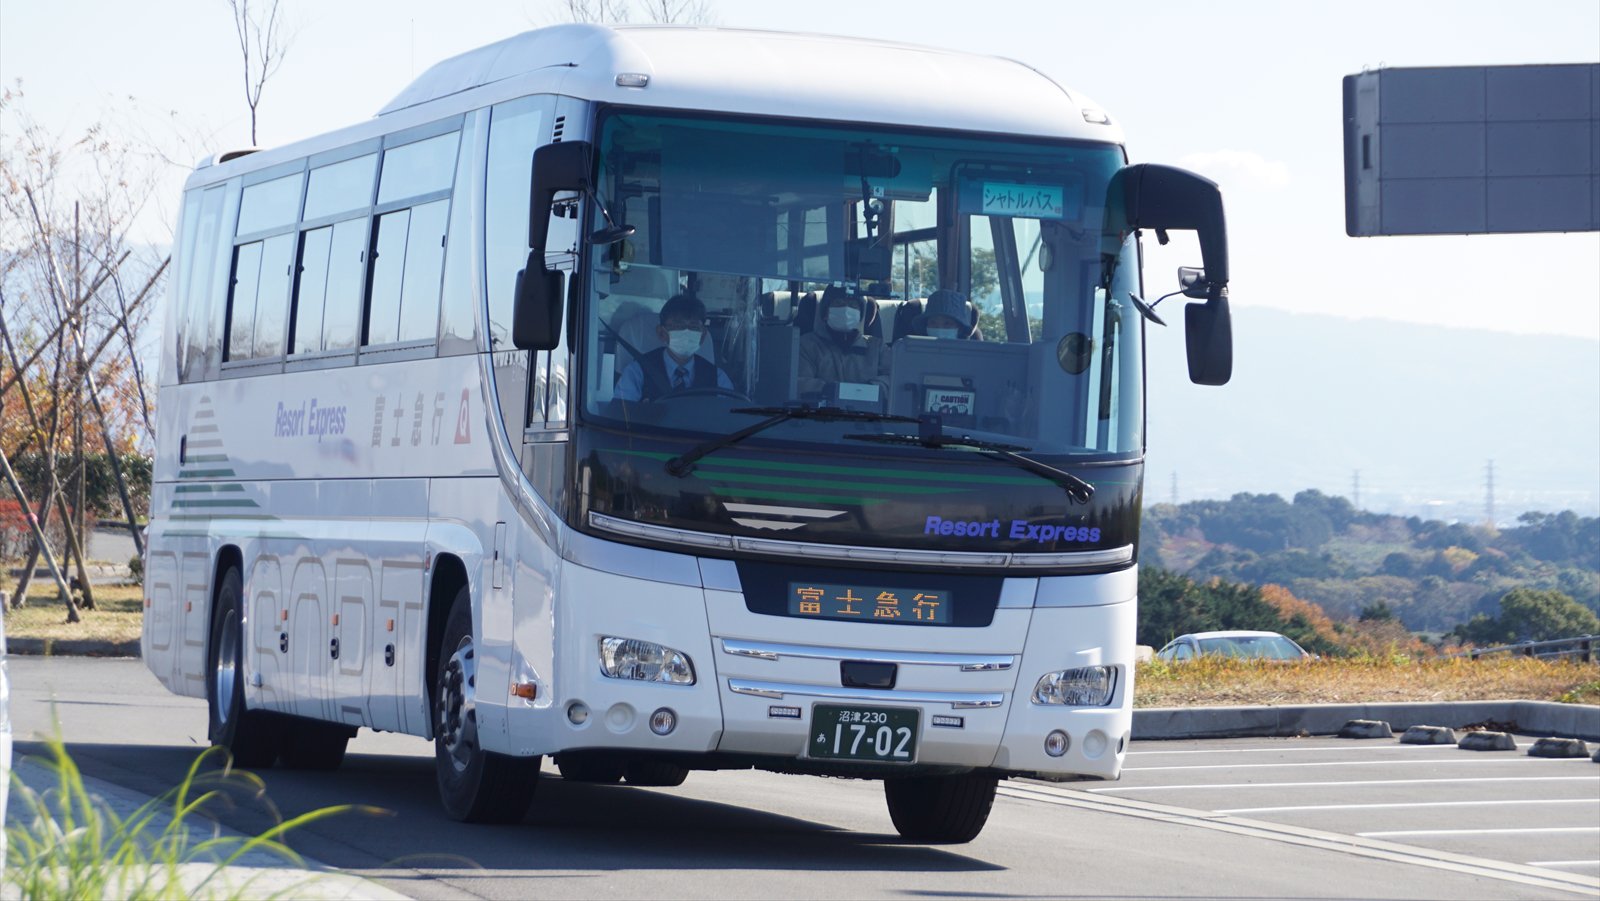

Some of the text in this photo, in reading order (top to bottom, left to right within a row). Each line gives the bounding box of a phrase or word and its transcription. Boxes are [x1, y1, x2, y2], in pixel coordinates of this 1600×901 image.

[985, 188, 1053, 210] シャトルバス
[940, 395, 969, 404] CAUTION
[274, 398, 347, 443] Resort Express
[371, 391, 445, 447] 富士急行
[924, 516, 1101, 543] Resort Express
[797, 587, 940, 620] 富士急行
[816, 723, 912, 757] あ 17-02
